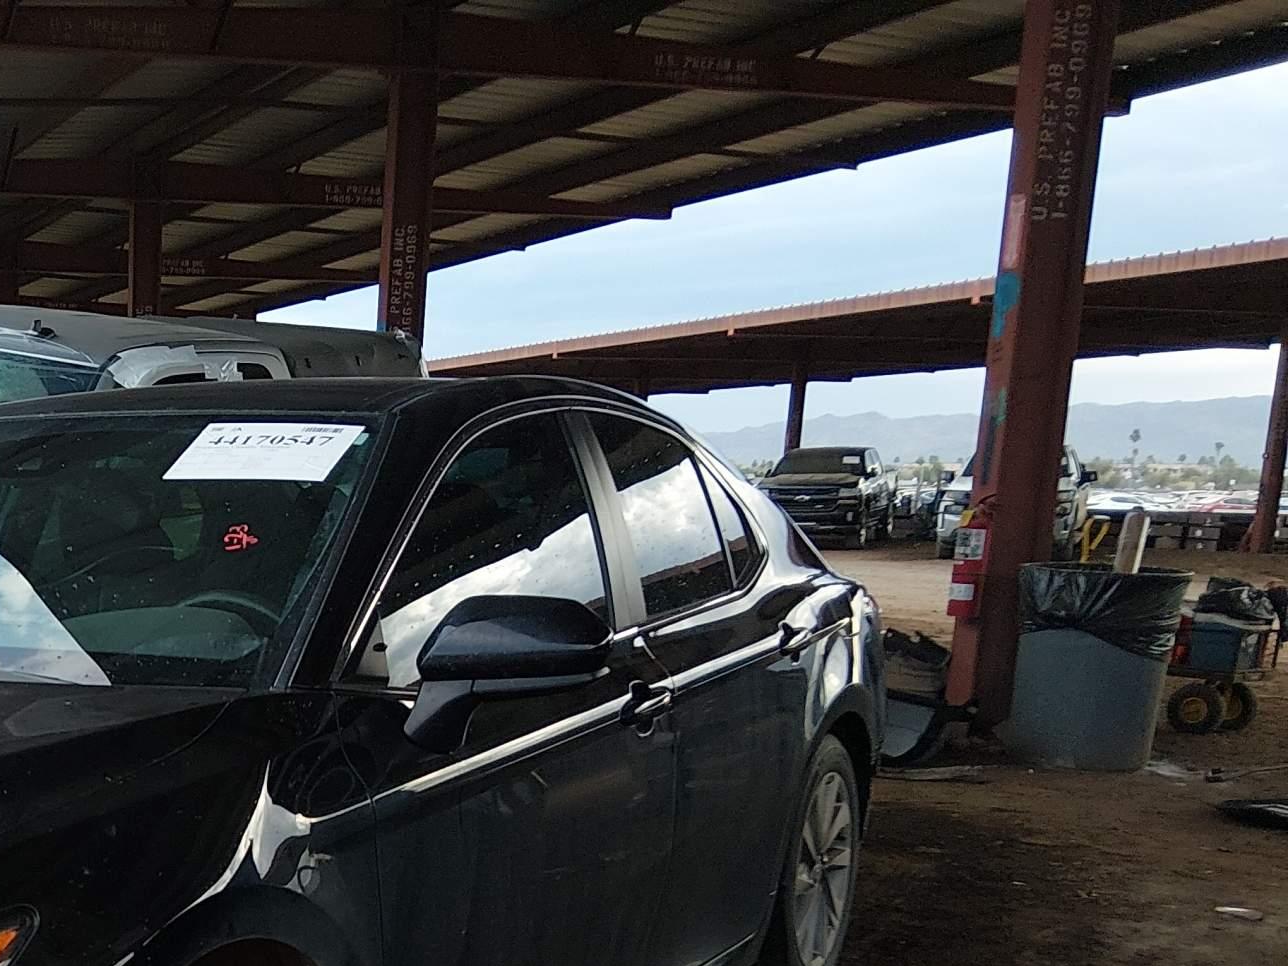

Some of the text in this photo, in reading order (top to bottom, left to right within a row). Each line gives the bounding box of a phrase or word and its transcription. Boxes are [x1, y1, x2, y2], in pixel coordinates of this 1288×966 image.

[1038, 63, 1065, 159] PREFAB
[390, 258, 404, 313] PREFAB
[208, 435, 335, 446] 44170547
